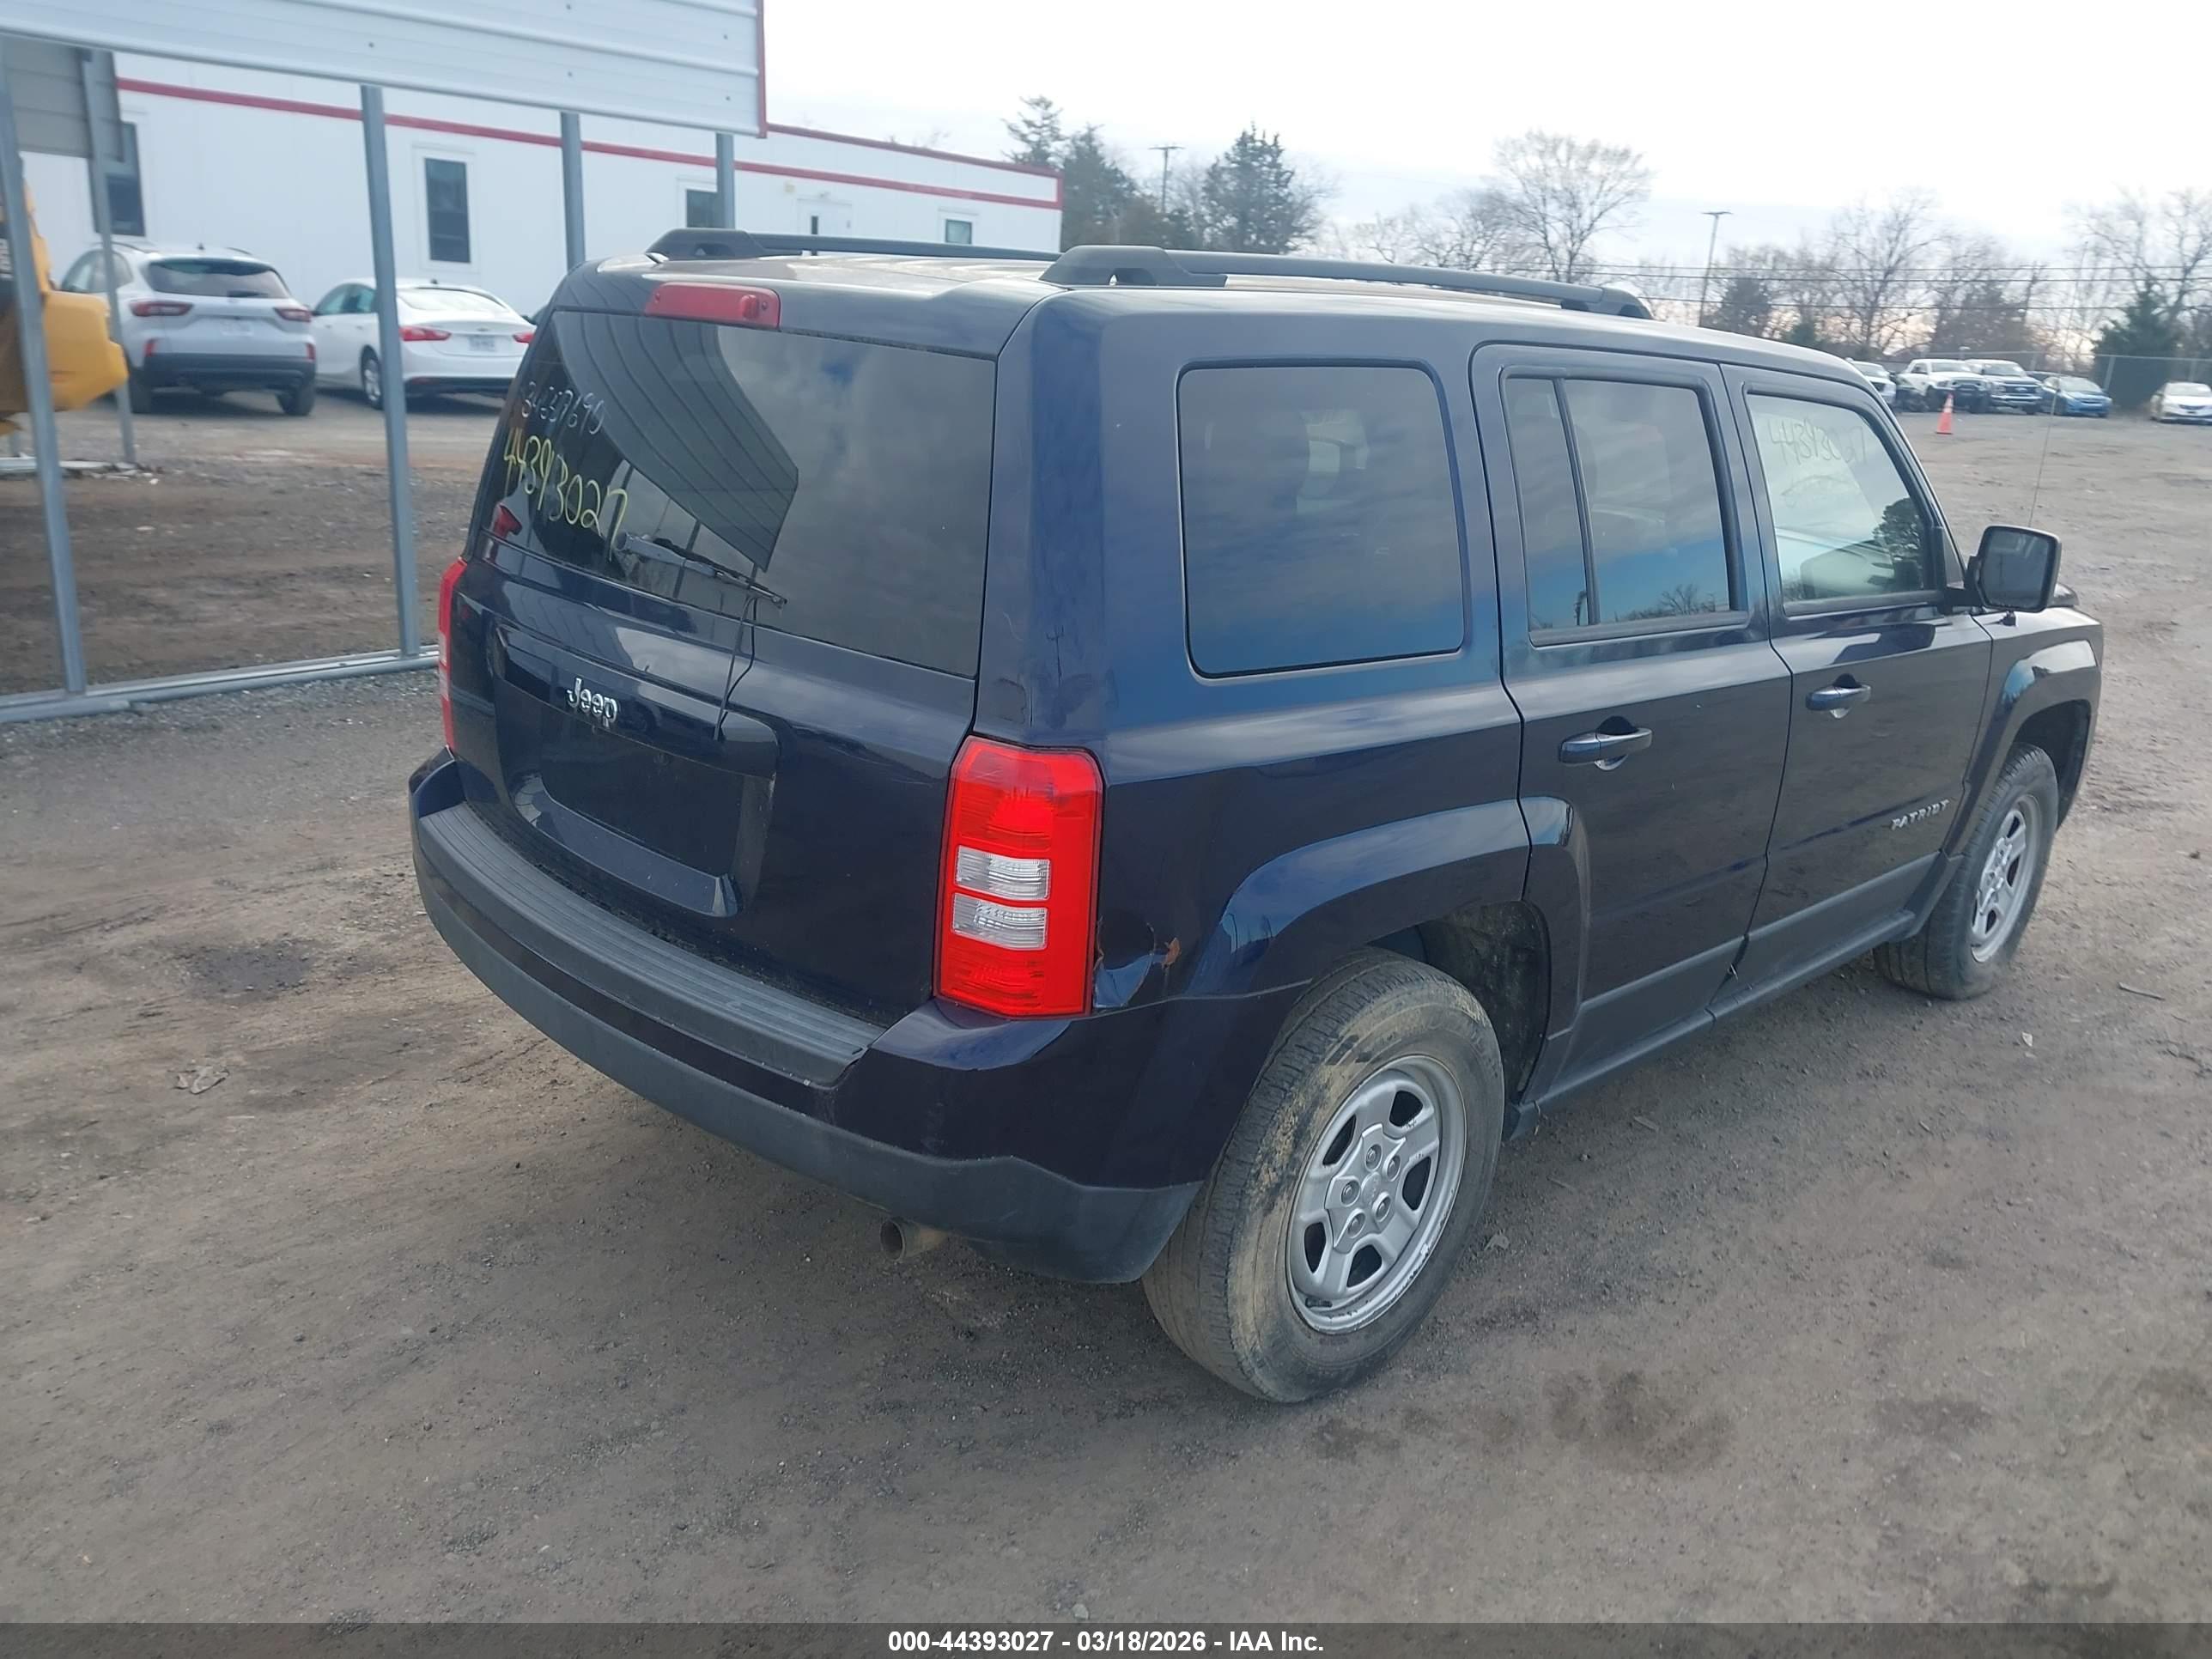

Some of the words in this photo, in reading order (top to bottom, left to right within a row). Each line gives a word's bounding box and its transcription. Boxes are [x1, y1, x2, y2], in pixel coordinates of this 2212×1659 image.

[503, 427, 629, 562] 44393027
[566, 677, 617, 728] Jeep
[1891, 798, 1950, 831] PATRIOT
